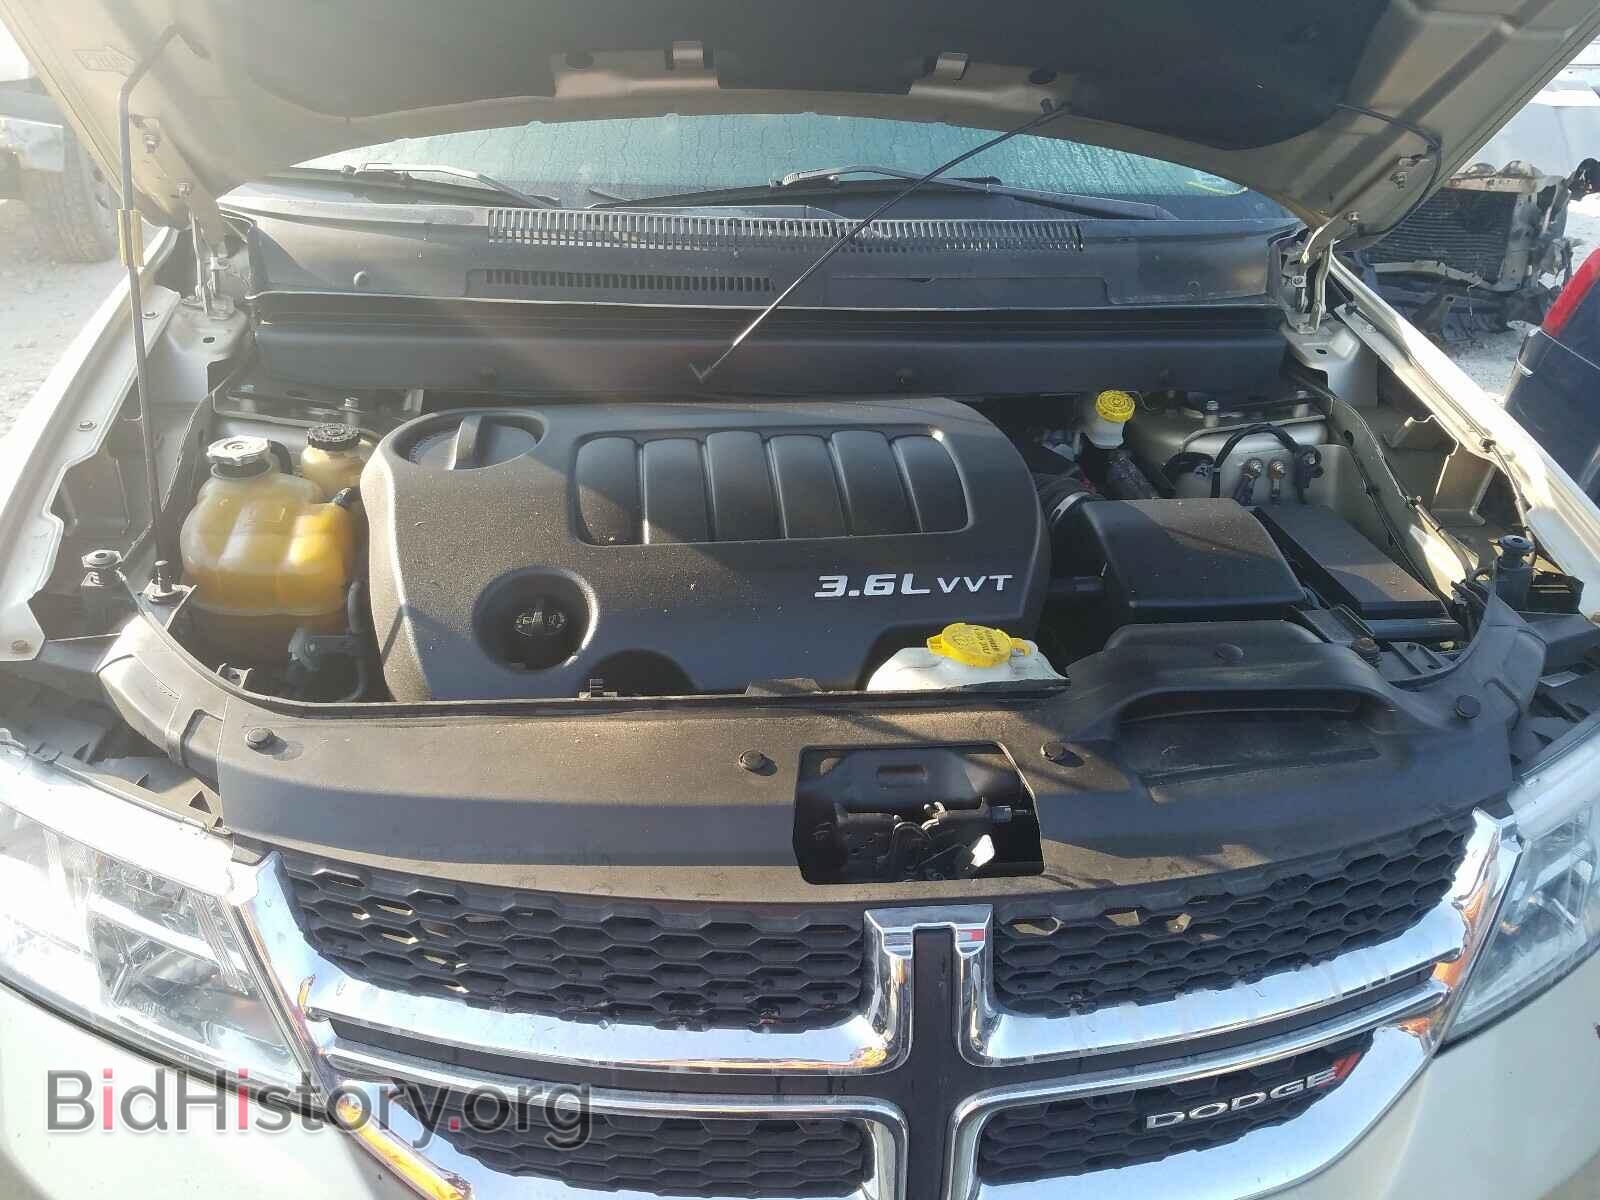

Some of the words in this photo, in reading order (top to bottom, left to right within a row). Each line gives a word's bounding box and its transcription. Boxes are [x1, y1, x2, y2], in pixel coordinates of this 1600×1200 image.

[814, 573, 931, 598] 3.6L
[937, 574, 1013, 594] VVT
[1146, 1066, 1337, 1129] DODGE
